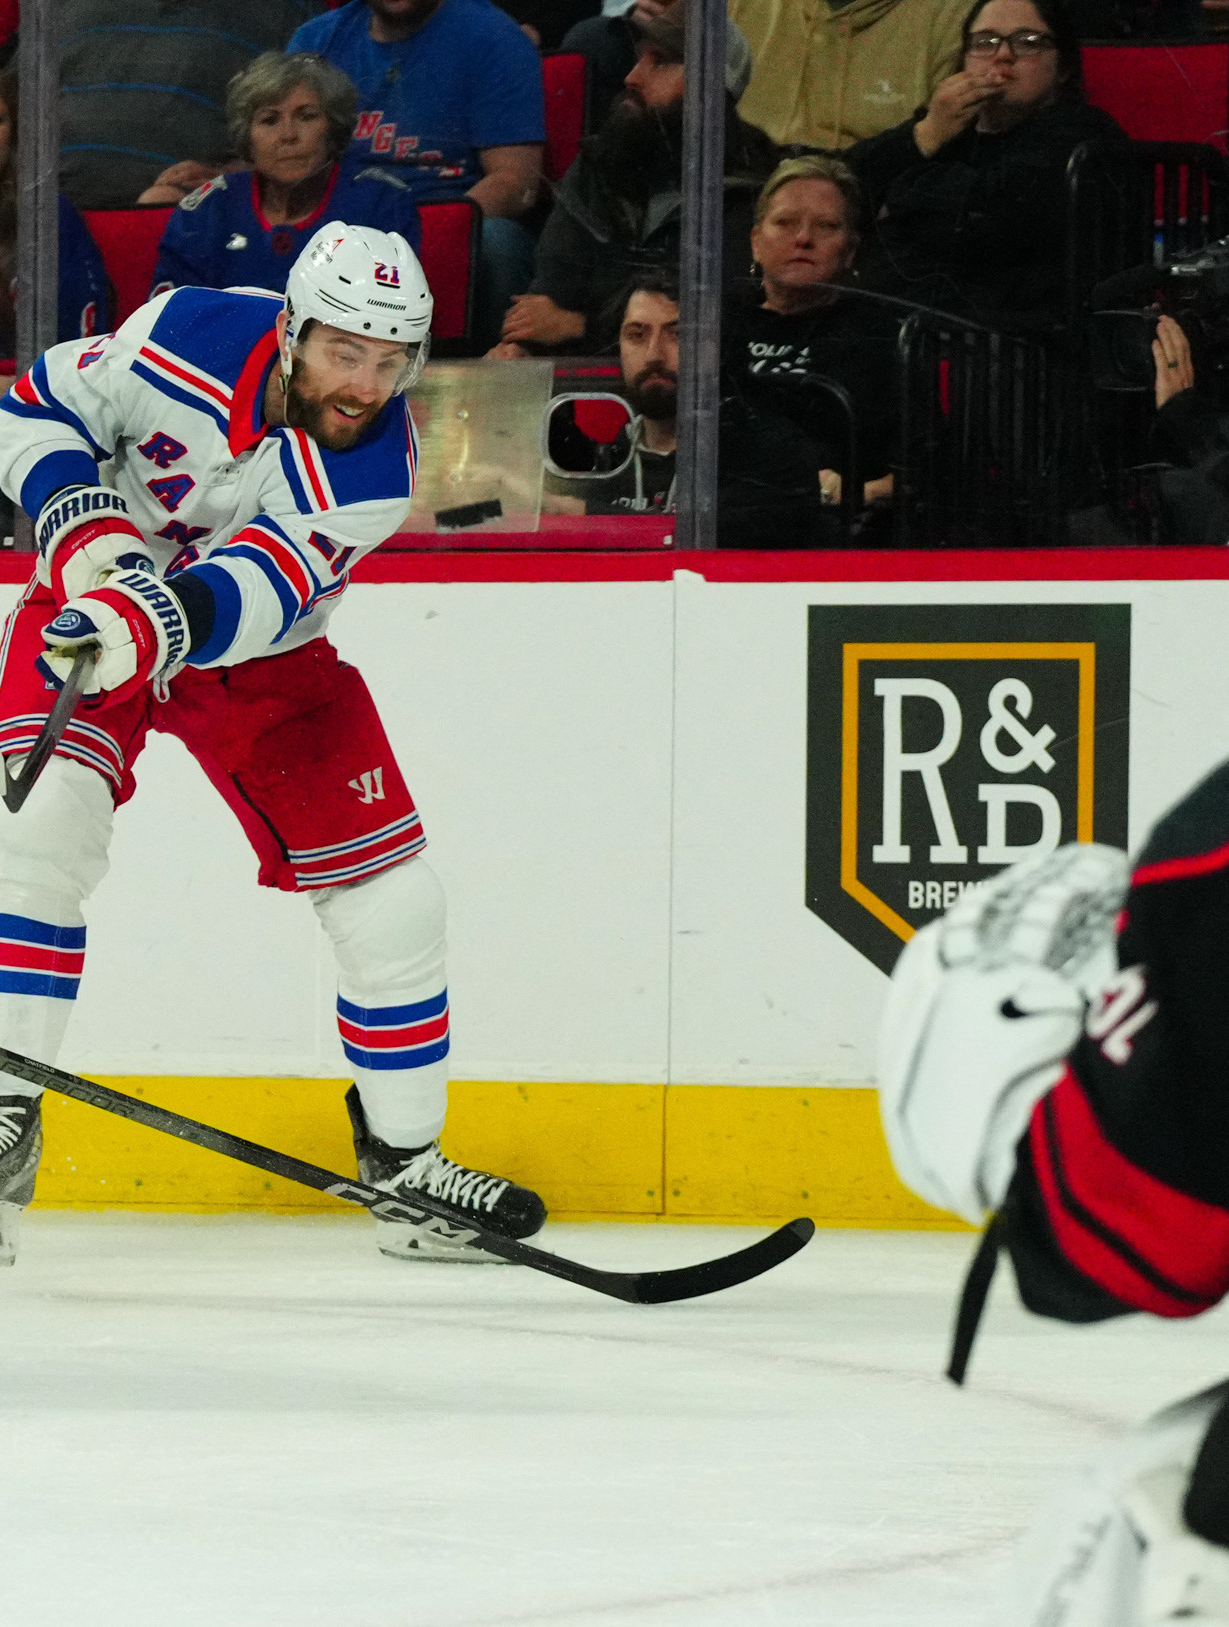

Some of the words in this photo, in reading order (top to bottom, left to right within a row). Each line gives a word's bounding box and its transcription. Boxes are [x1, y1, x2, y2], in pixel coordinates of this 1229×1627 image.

[374, 262, 400, 284] 21
[367, 298, 407, 311] WARRIOR
[323, 1181, 480, 1246] CCM
